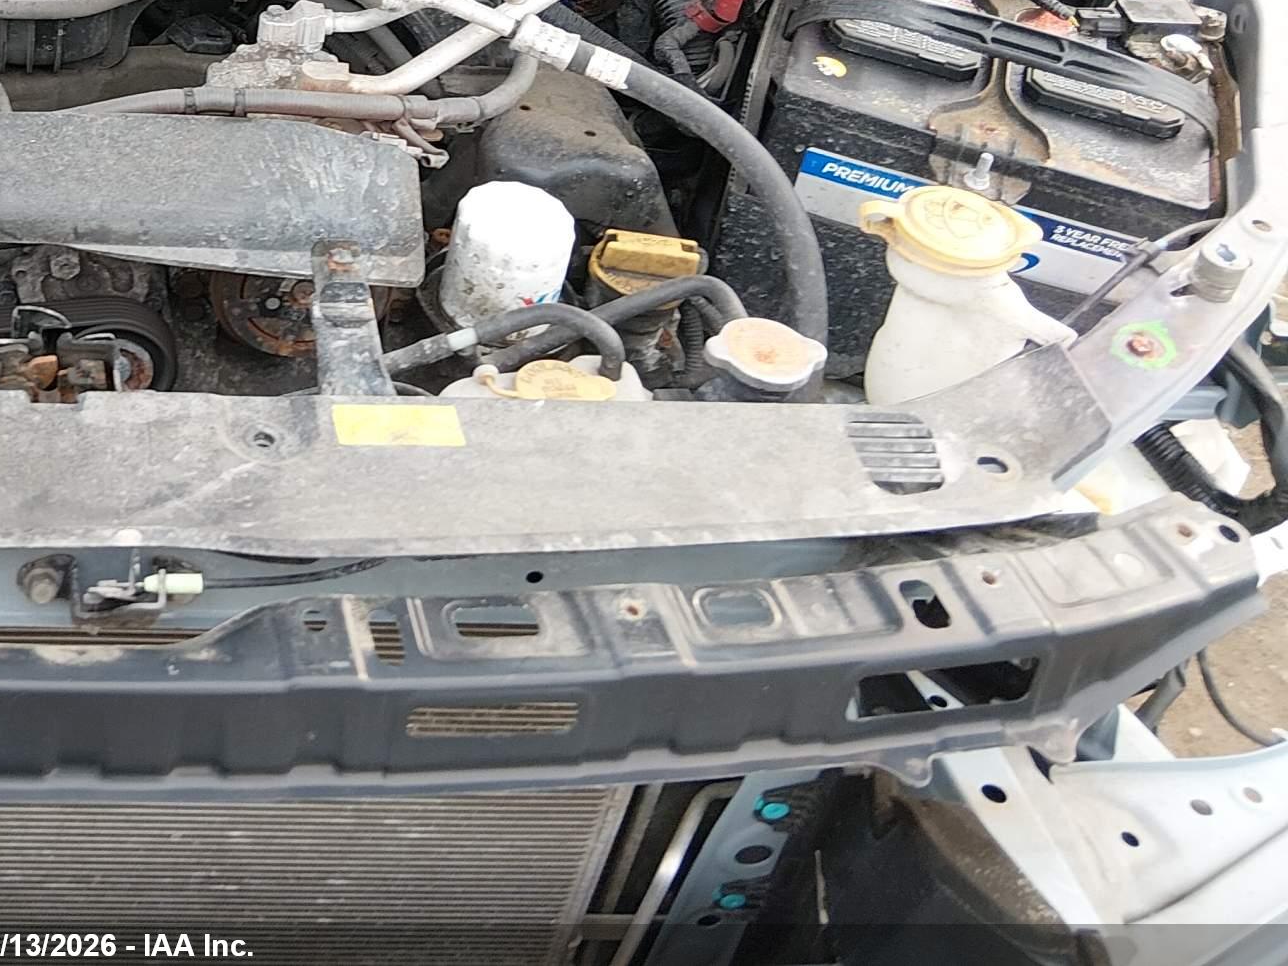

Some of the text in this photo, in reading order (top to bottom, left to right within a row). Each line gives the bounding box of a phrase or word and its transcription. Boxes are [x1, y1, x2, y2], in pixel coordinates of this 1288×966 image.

[821, 162, 916, 193] PREMIUM
[1050, 233, 1123, 258] REPLACEMEN
[1065, 227, 1102, 244] YEAR
[1099, 238, 1132, 251] FRE
